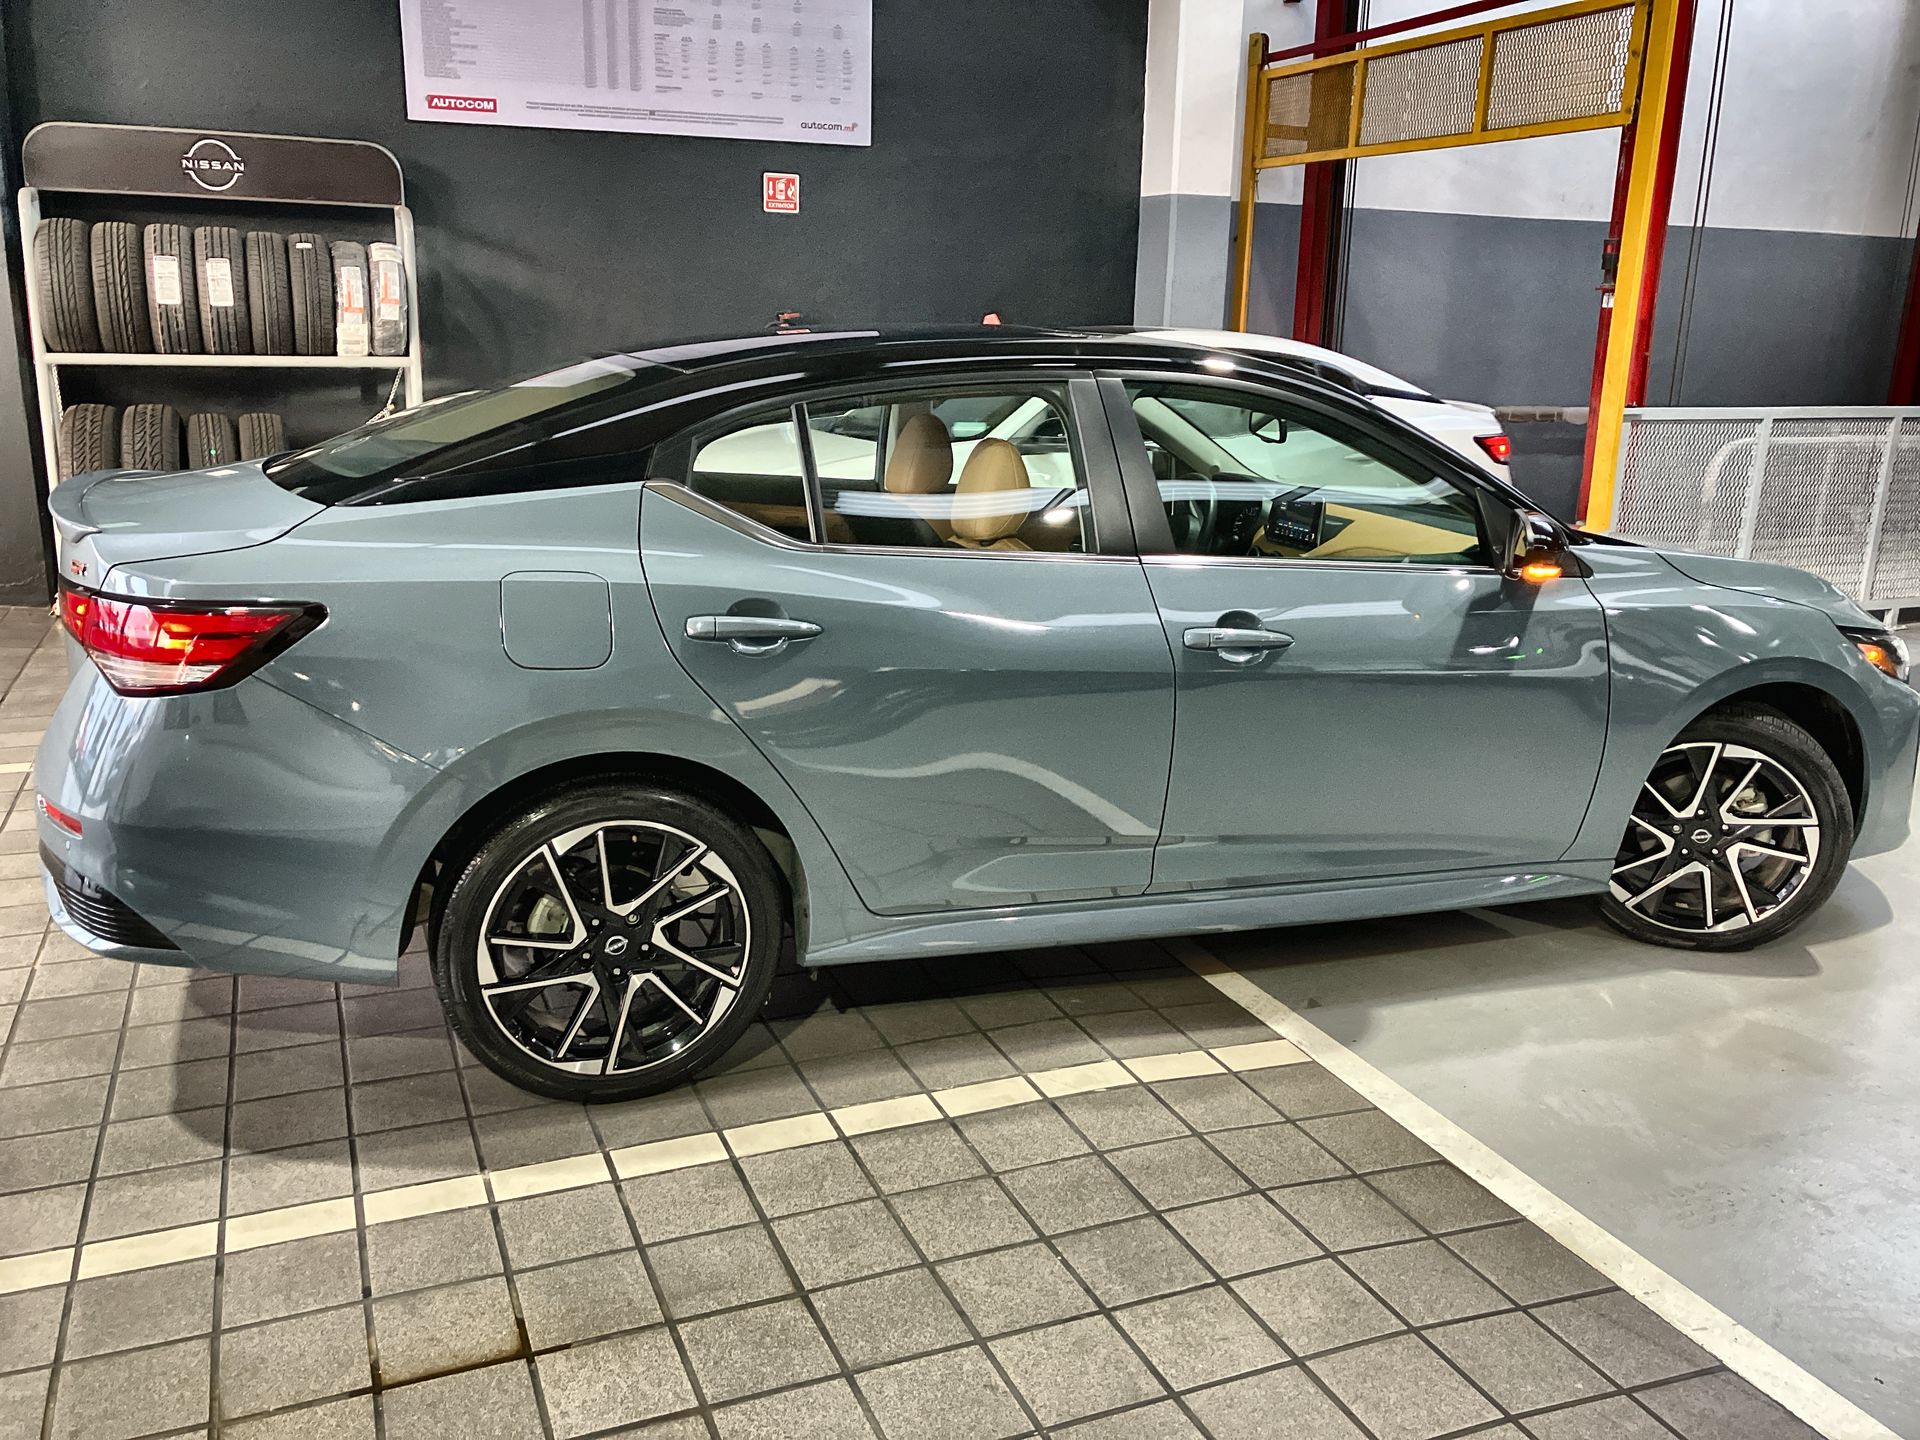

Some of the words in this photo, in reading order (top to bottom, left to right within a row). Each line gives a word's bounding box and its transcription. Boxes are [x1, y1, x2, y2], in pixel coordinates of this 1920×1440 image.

[431, 97, 494, 110] AUTOCOM
[181, 159, 245, 171] NISSAN
[768, 201, 795, 209] EXTINTOR
